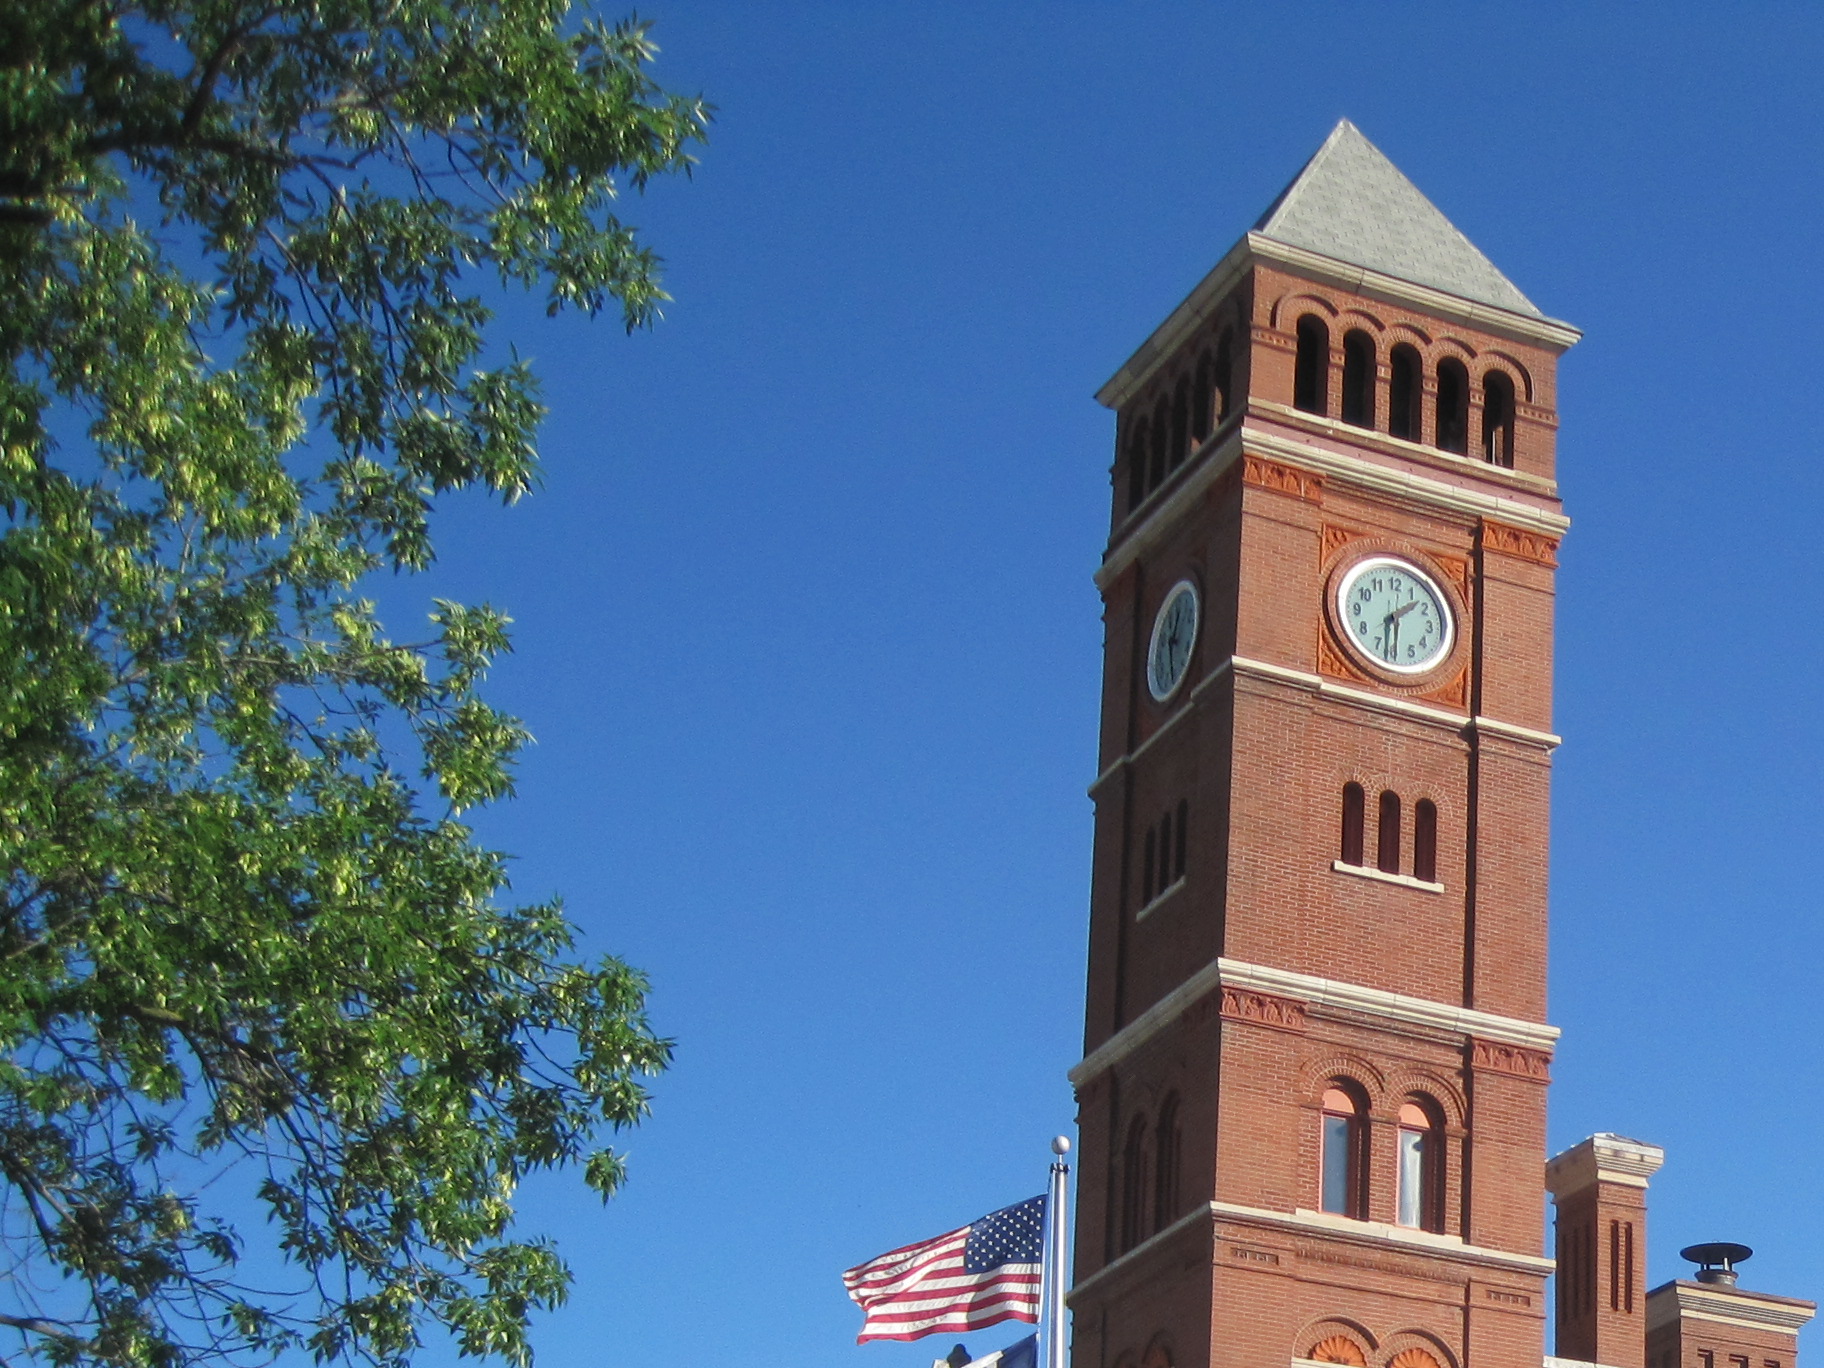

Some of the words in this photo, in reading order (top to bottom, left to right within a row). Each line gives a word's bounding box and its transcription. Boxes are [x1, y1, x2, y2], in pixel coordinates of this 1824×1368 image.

[1371, 578, 1383, 592] 11
[1388, 577, 1402, 592] 12
[1359, 587, 1372, 602] 10
[1353, 603, 1361, 616] 9
[1421, 603, 1429, 616] 2
[1359, 621, 1367, 634] 8
[1425, 621, 1434, 634] 3
[1374, 636, 1382, 650] 7
[1419, 635, 1427, 648] 4
[1407, 645, 1415, 658] 5
